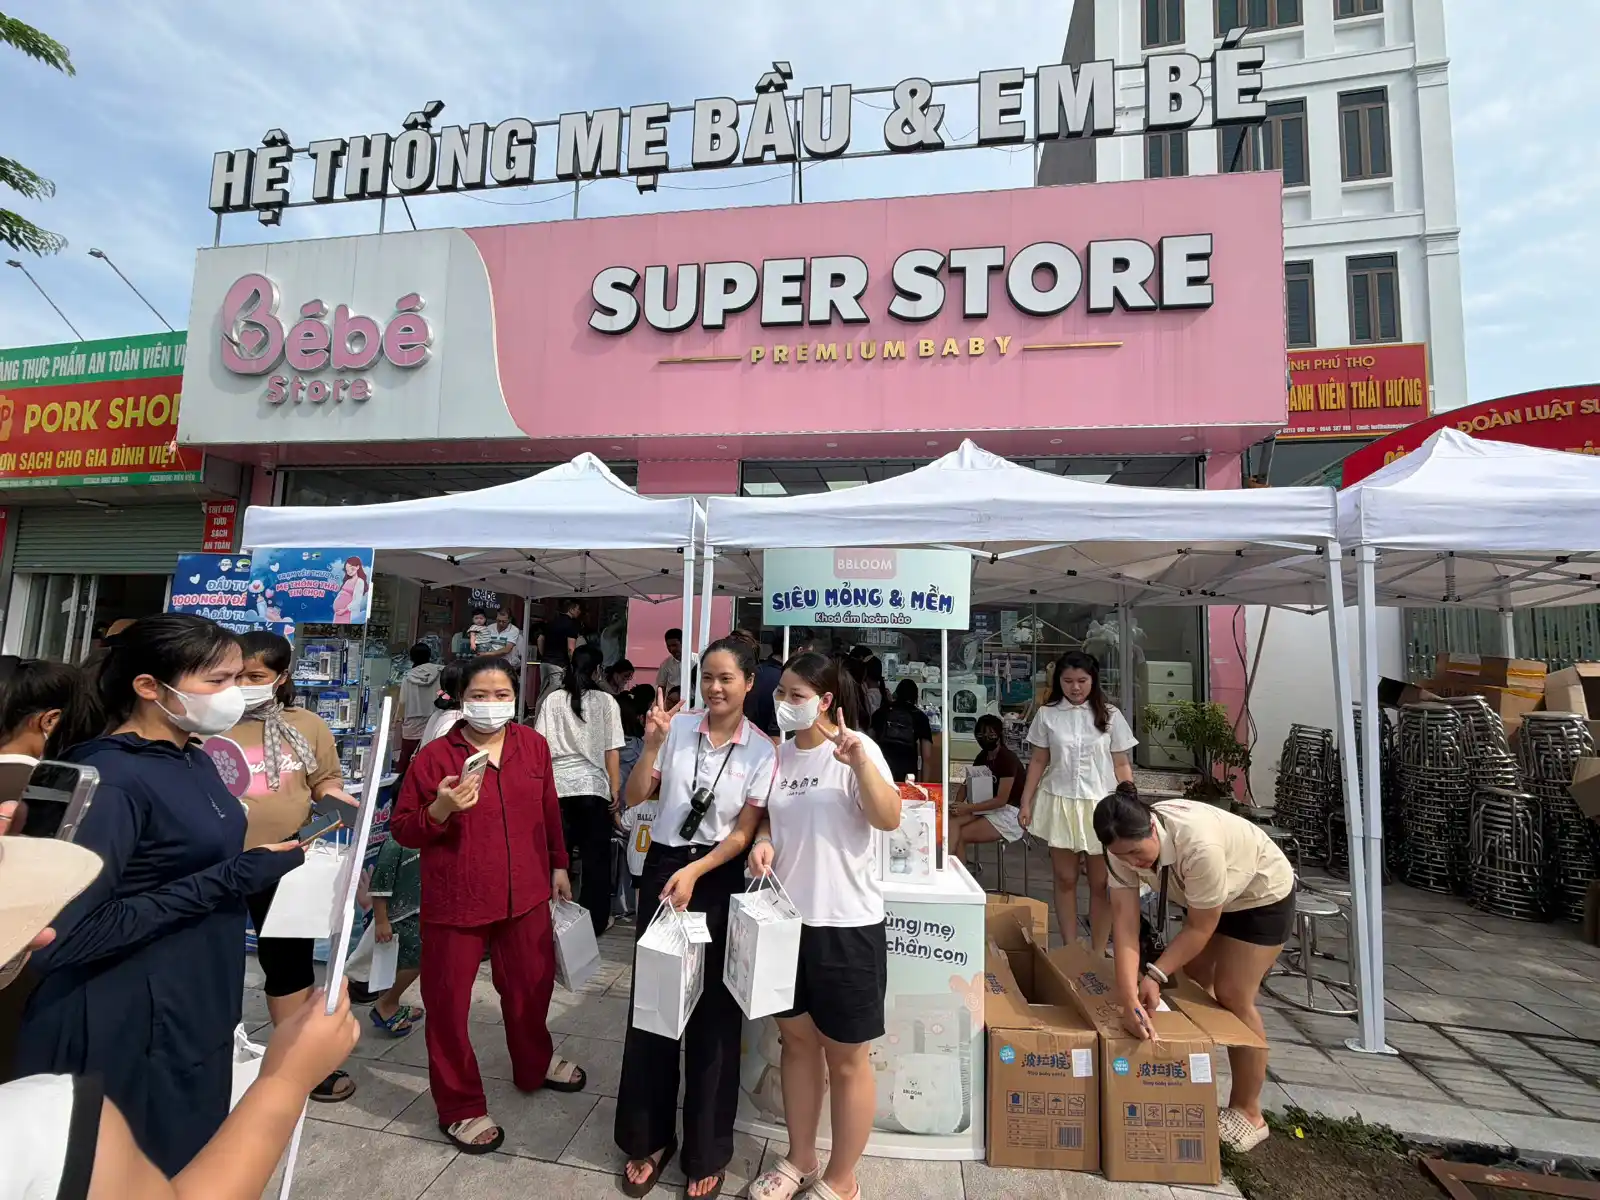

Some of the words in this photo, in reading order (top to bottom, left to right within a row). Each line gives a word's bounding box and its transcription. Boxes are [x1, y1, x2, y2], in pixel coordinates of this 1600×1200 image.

[209, 127, 295, 226] HỆ
[309, 100, 537, 202] THỐNG
[556, 103, 671, 193] MẸ
[691, 61, 853, 170] BẦU
[883, 77, 945, 154] &
[977, 58, 1116, 146] EM
[1145, 26, 1268, 132] BÉ
[588, 254, 870, 336] SUPER
[887, 232, 1215, 322] STORE
[221, 272, 434, 376] Bébé
[22, 356, 50, 384] THỰC
[52, 345, 87, 377] PHẨM
[88, 352, 106, 374] AN
[109, 344, 140, 373] TOÀN
[143, 341, 172, 369] VIÊN
[174, 343, 187, 367] VI
[750, 339, 908, 364] PREMIUM
[917, 334, 1014, 357] BABY
[1314, 354, 1340, 370] PHÚ
[1345, 355, 1375, 370] THỌ
[1317, 376, 1346, 410] VIÊN
[1350, 375, 1380, 409] THÁI
[1384, 376, 1423, 408] HƯNG
[24, 399, 102, 434] PORK
[1456, 408, 1522, 434] ĐOÀN
[1525, 399, 1575, 422] LUẬT
[19, 451, 53, 474] SẠCH
[56, 450, 82, 469] CHO
[86, 447, 109, 467] GIA
[111, 443, 145, 465] ĐÌNH
[149, 441, 177, 468] VIỆT
[204, 541, 213, 549] AN
[837, 558, 893, 571] BBLOOM
[172, 594, 201, 606] 1000
[200, 592, 232, 605] NGÀY
[288, 588, 302, 597] TIN
[303, 588, 326, 598] CHỌN
[772, 585, 819, 613] SIÊU
[824, 581, 883, 608] MỎNG
[888, 588, 905, 609] &
[910, 583, 955, 614] MỀM
[815, 612, 841, 624] Khoá
[862, 612, 889, 624] hoàn
[891, 612, 912, 625] hảo
[924, 921, 955, 942] mẹ
[933, 947, 967, 966] con
